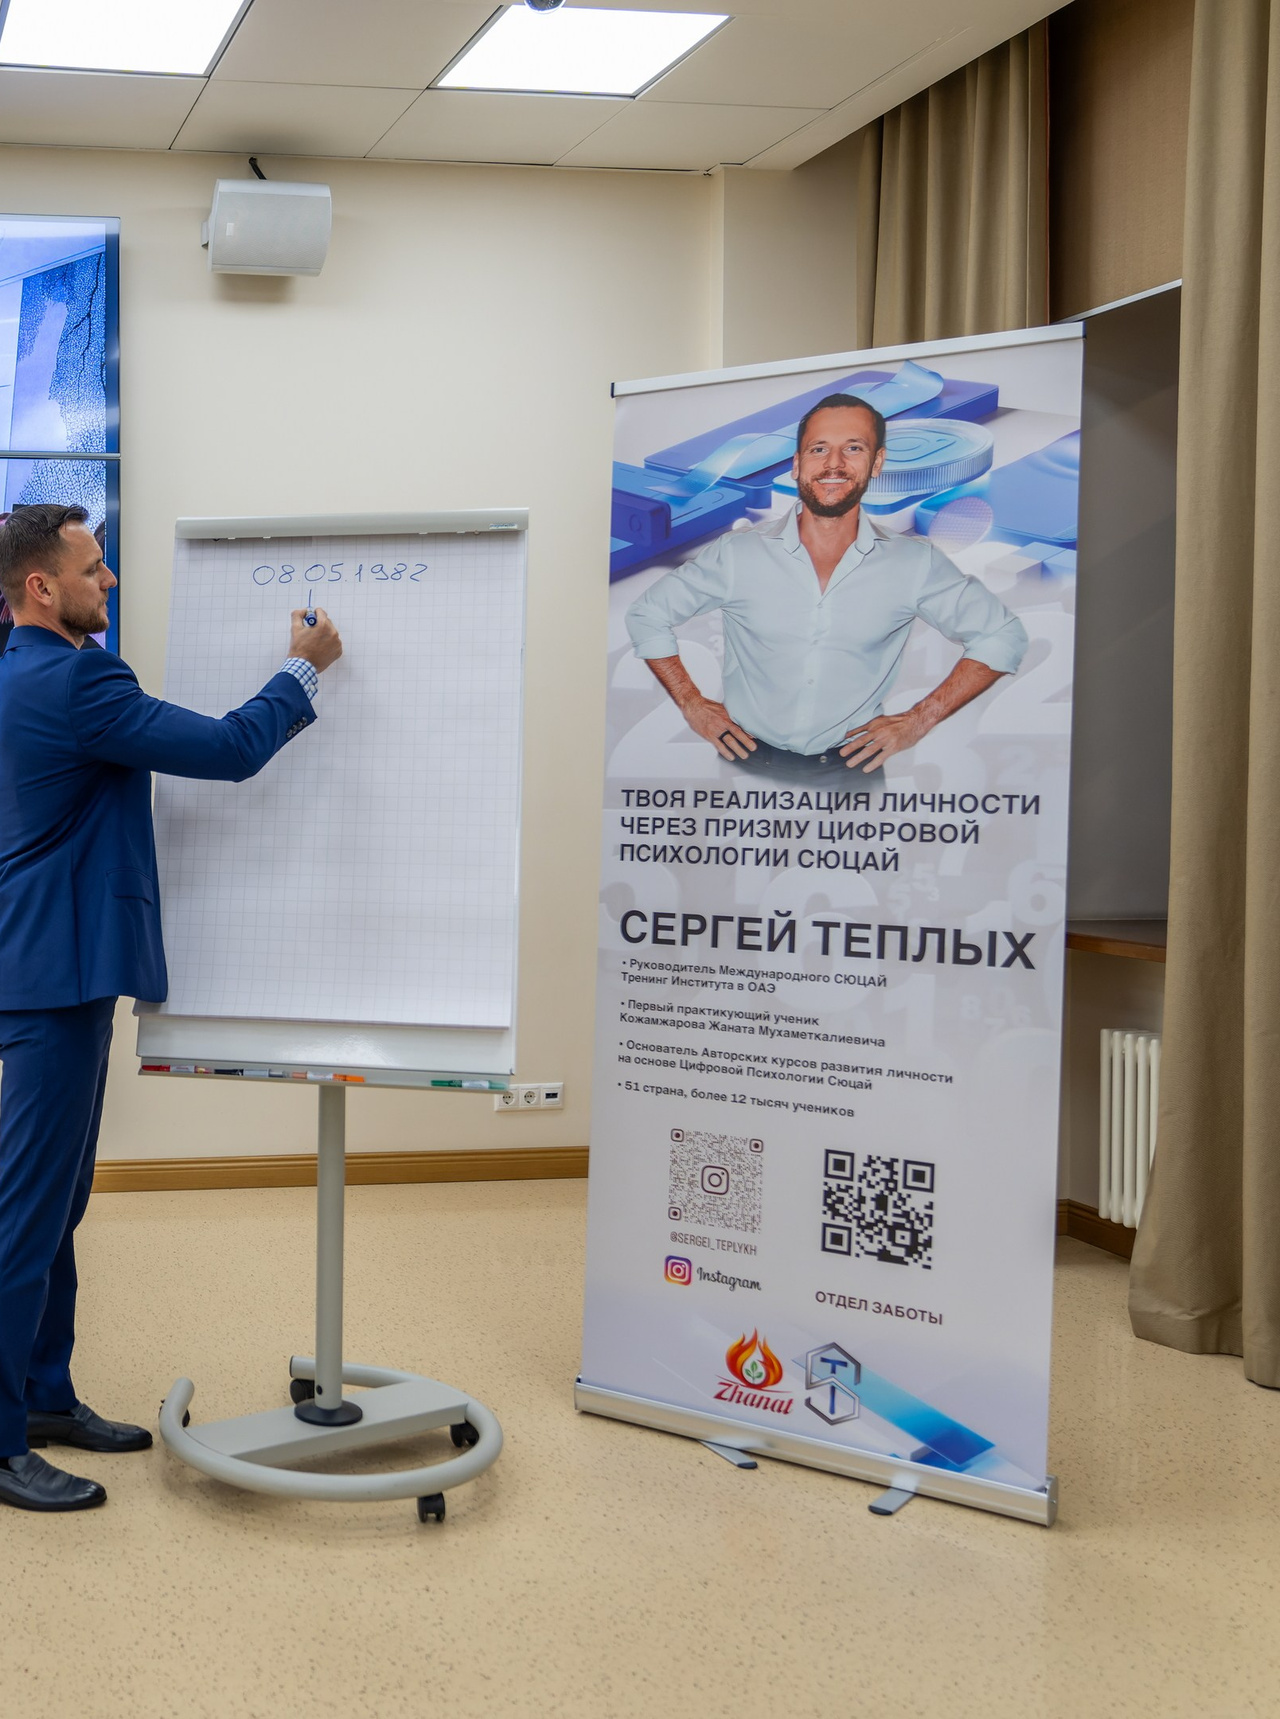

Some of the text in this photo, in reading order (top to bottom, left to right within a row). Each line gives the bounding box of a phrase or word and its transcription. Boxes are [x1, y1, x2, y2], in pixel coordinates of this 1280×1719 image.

[252, 562, 429, 586] 08.05.1982
[620, 789, 1041, 815] ТВОЯ РЕАЛИЗАЦИЯ ЛИЧНОСТИ
[620, 816, 980, 844] ЧЕРЕЗ ПРИЗМУ ЦИФРОВОЙ
[620, 843, 900, 874] ПСИХОЛОГИИ СЮЦАЙ
[620, 910, 1037, 970] СЕРГЕЙ ТЕПЛЫХ
[621, 971, 776, 994] Тренинг Института в ОАЭ
[630, 958, 887, 988] Руководитель Международного СЮЦАЙ
[627, 999, 820, 1026] Первый практикующий ученик
[619, 1012, 886, 1048] Кожамжарова Жаната Мухаметкалиевича
[617, 1054, 873, 1091] на основе Цифровой Психологии Сюцай
[626, 1039, 954, 1084] Основатель Авторских курсов развития личности
[625, 1081, 855, 1118] 51 страна, более 12 тысяч учеников
[670, 1231, 758, 1256] @SERGEI_TEPLYKH
[696, 1266, 762, 1292] Instagram
[815, 1291, 944, 1326] ОТДЕЛ ЗАБОТЫ
[713, 1381, 795, 1416] Zhanat
